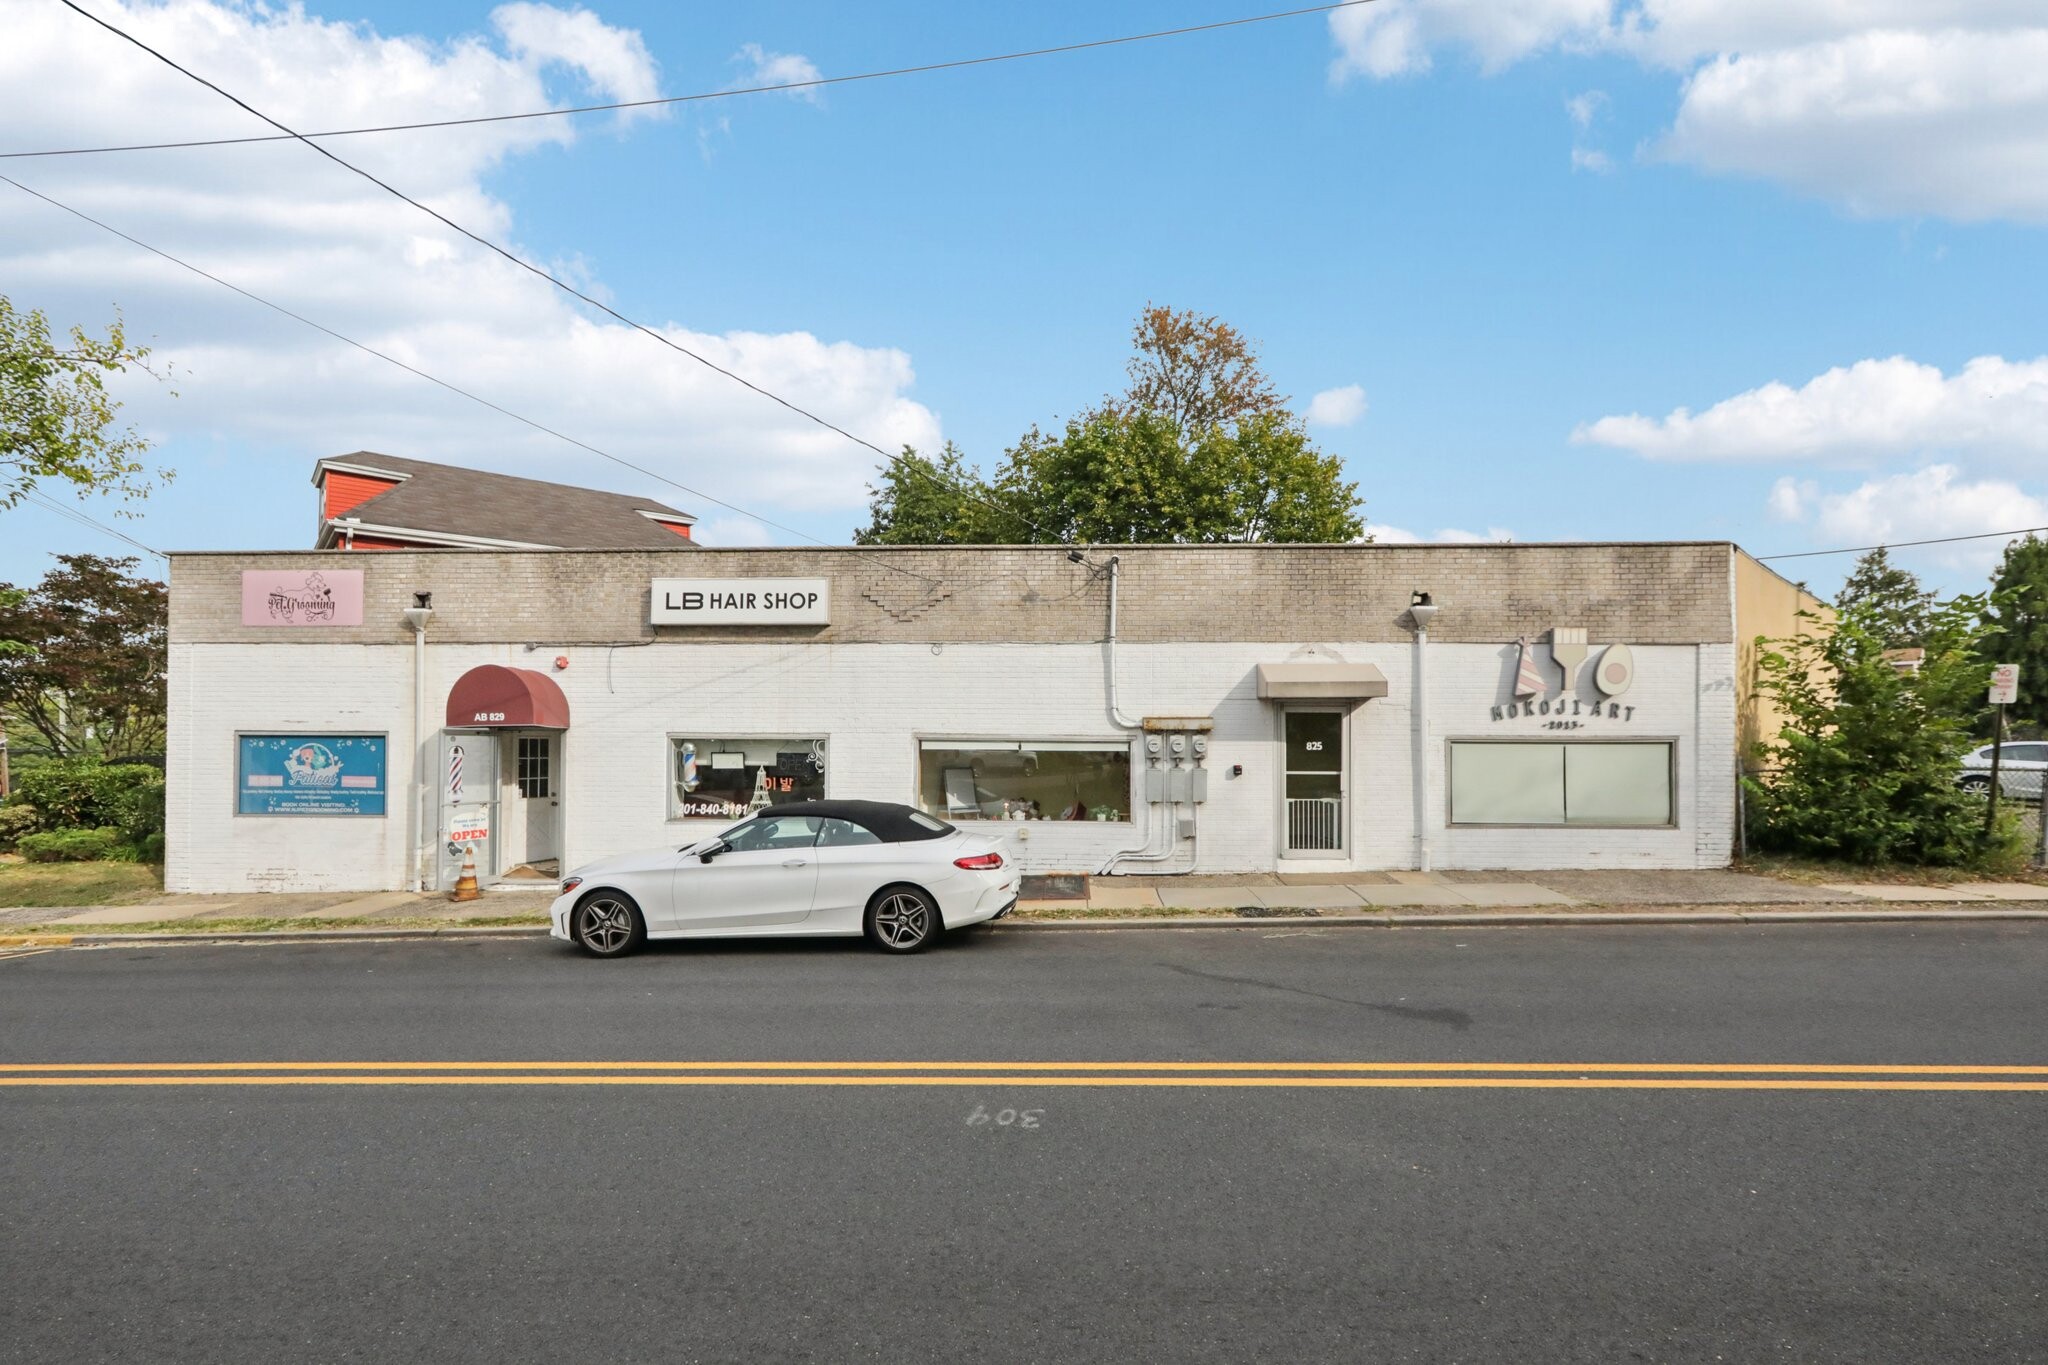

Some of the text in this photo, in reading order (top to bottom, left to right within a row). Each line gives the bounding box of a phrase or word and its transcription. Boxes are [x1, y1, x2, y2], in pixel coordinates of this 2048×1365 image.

[665, 592, 818, 610] LB HAIR SHOP
[474, 712, 505, 721] AB 829
[1490, 699, 1636, 722] MOKOJI ART
[1306, 742, 1323, 750] 825
[451, 829, 487, 841] OPEN
